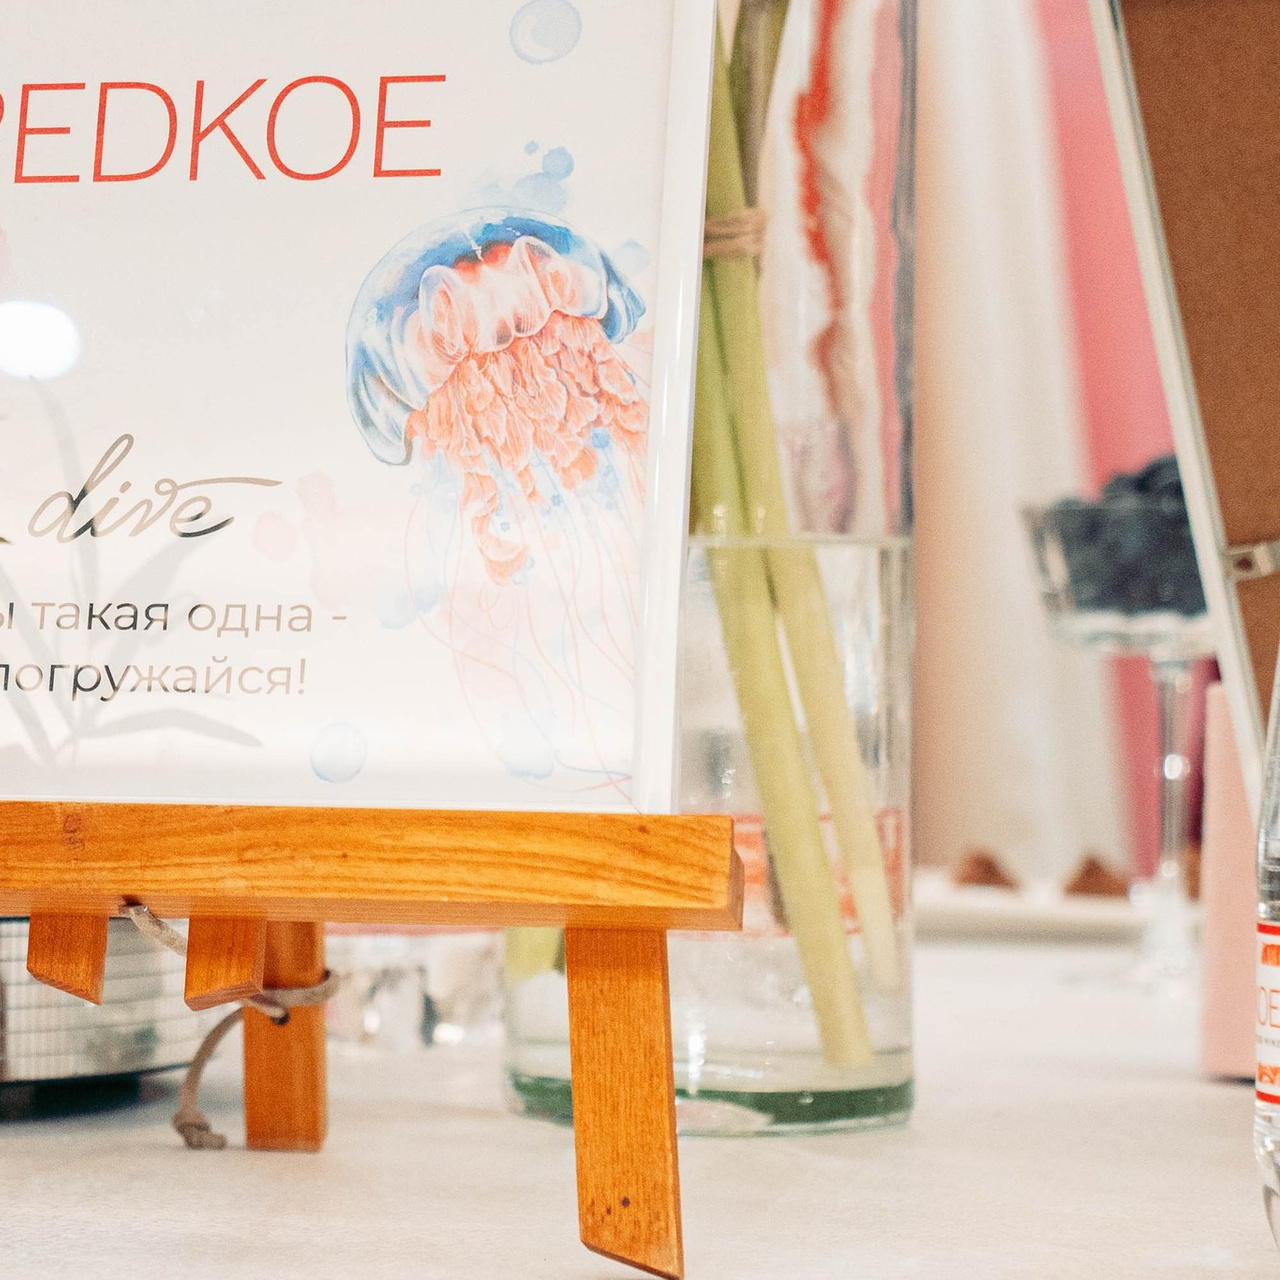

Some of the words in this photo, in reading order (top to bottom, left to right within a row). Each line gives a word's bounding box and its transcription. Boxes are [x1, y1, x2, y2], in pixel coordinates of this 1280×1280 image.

[27, 432, 284, 544] dive
[30, 601, 170, 632] такая
[187, 602, 313, 638] одна
